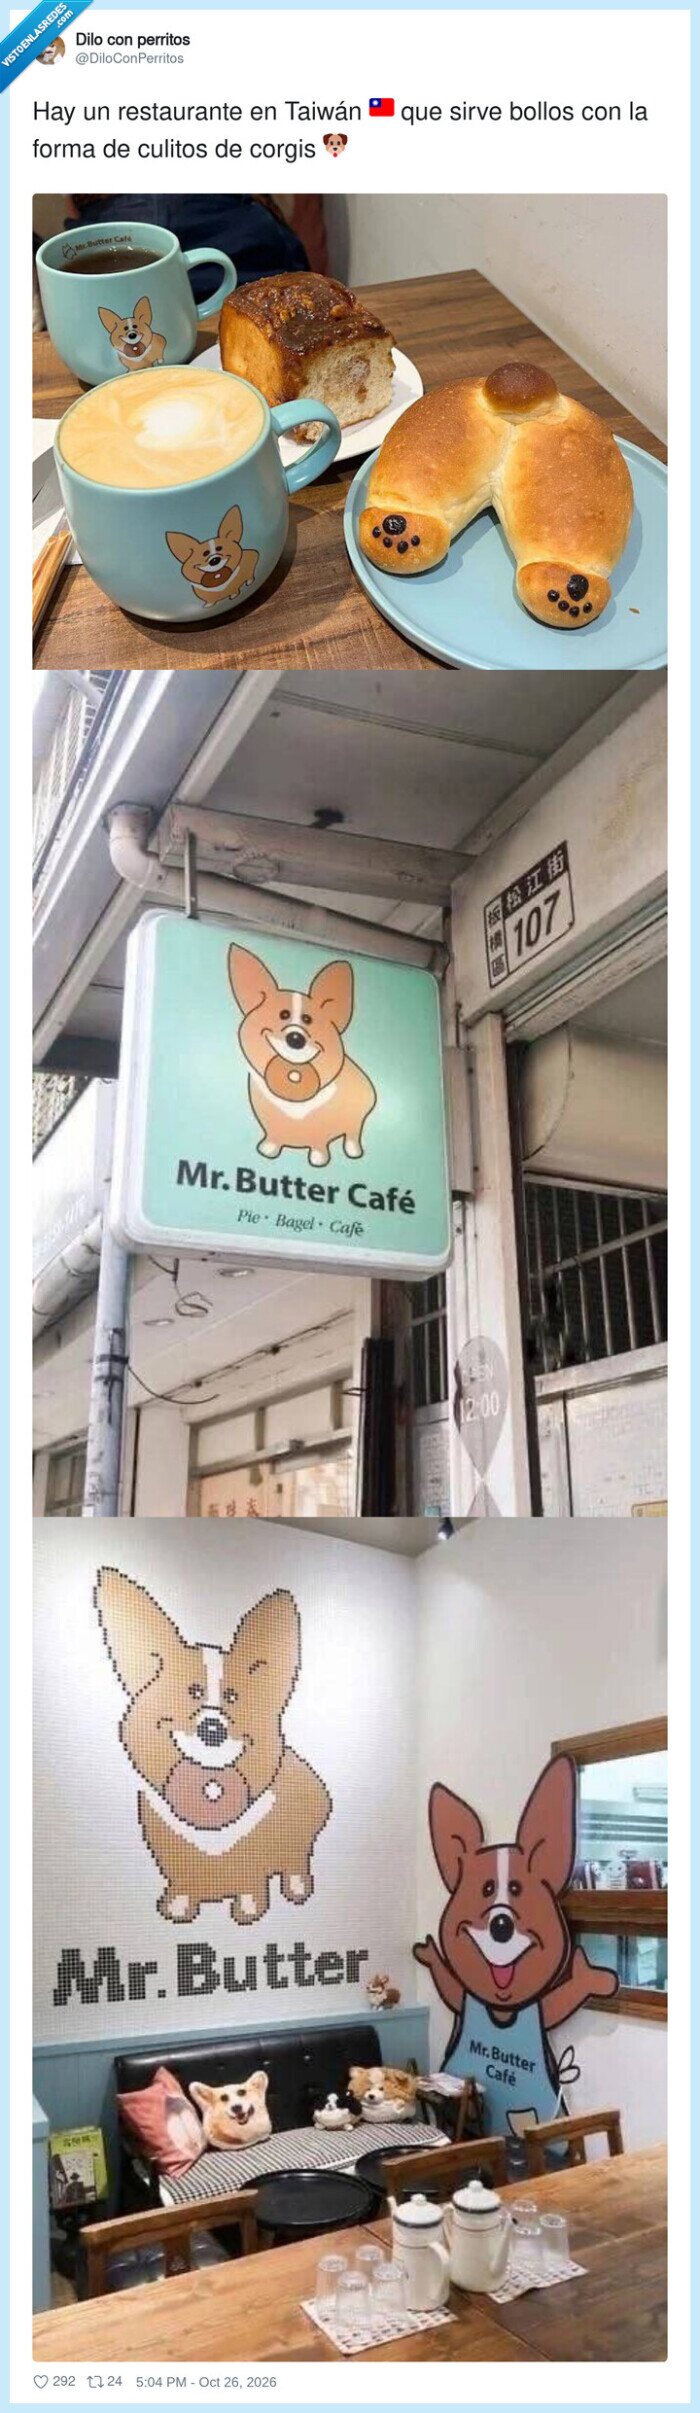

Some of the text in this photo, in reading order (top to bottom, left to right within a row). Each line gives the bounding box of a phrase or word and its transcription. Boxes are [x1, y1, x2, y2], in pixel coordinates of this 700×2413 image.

[87, 238, 112, 247] Butter
[506, 849, 565, 913] 松江街
[513, 889, 561, 957] 107
[176, 1159, 417, 1215] Mr. Butter Café
[237, 1208, 365, 1237] Pie Bagel Café
[460, 1390, 500, 1424] 12:00
[53, 1941, 369, 2007] Mr. Butter
[469, 2039, 536, 2072] Mr. Butter
[486, 2064, 516, 2086] Café
